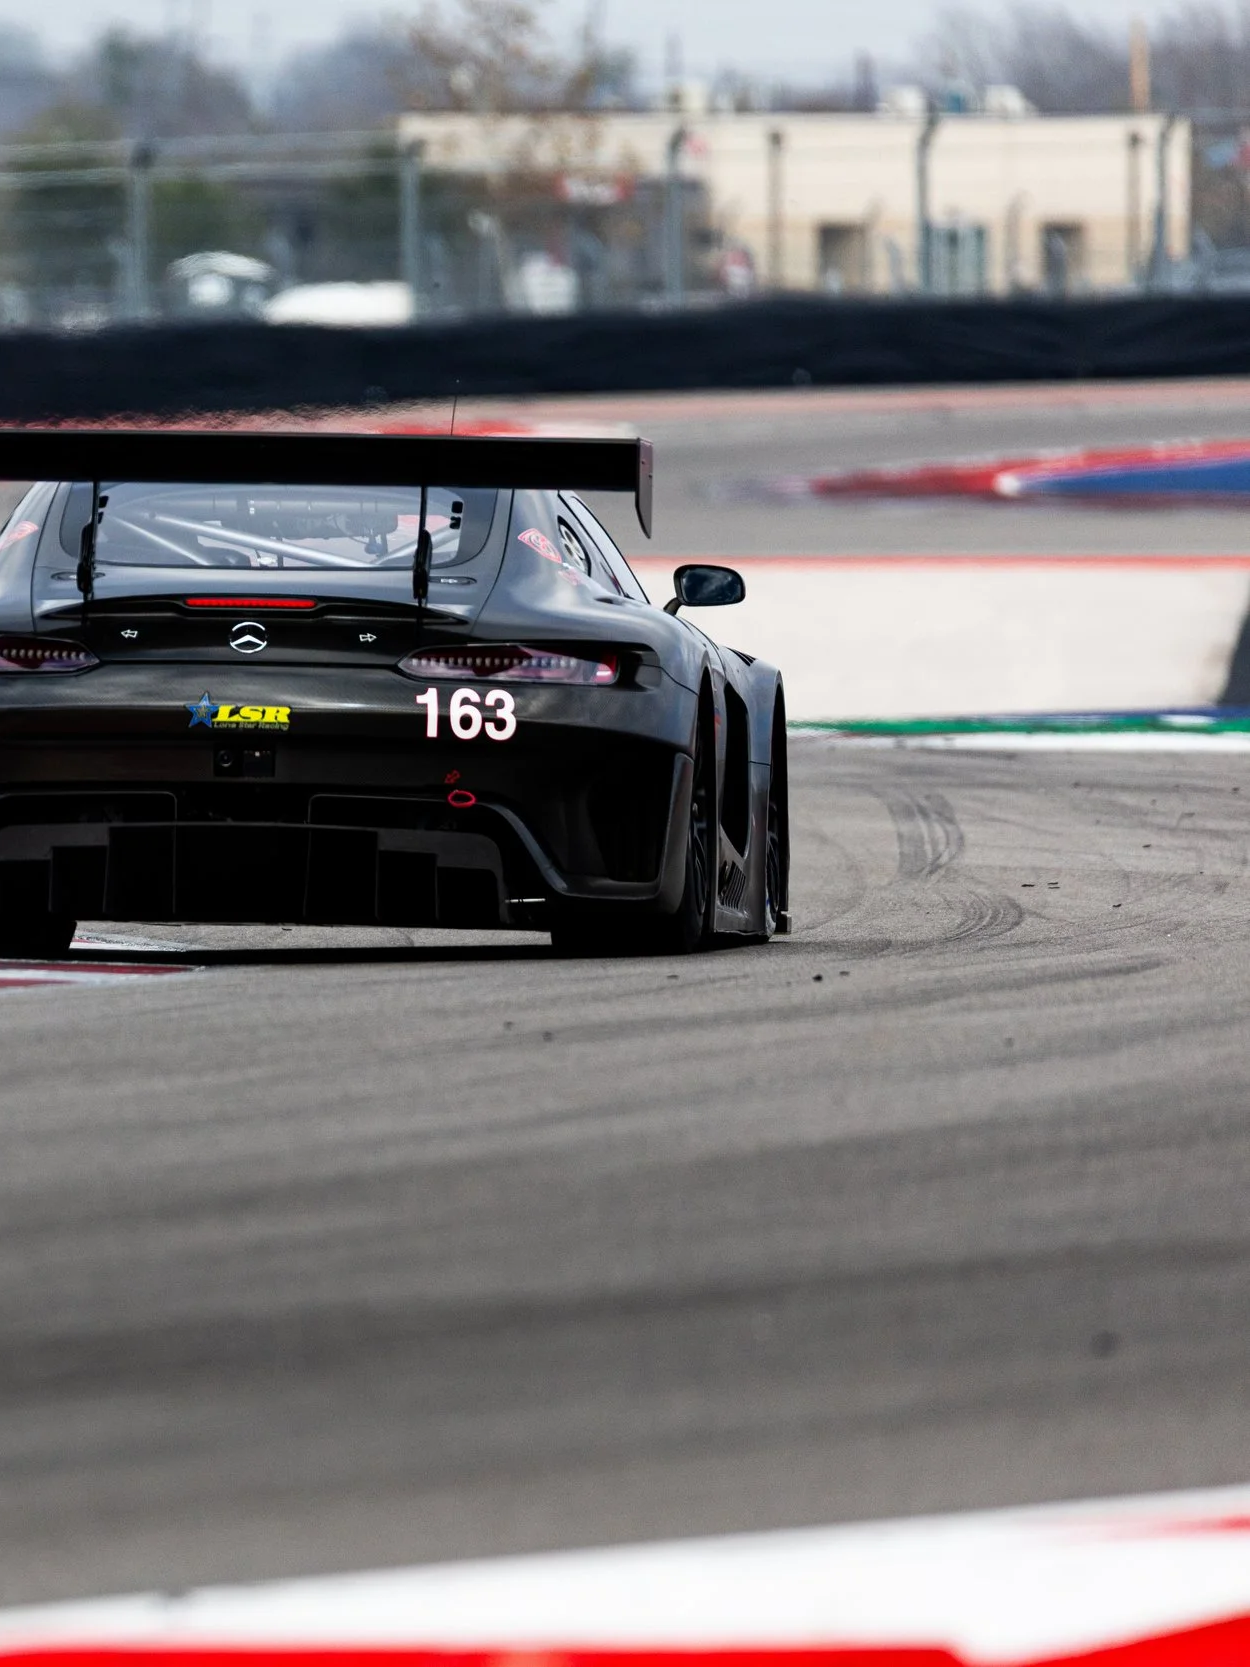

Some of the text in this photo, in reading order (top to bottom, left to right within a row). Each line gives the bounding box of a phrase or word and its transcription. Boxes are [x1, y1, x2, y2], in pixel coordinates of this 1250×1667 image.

[212, 705, 291, 723] LSR
[415, 687, 517, 741] 163
[258, 722, 290, 732] Racing
